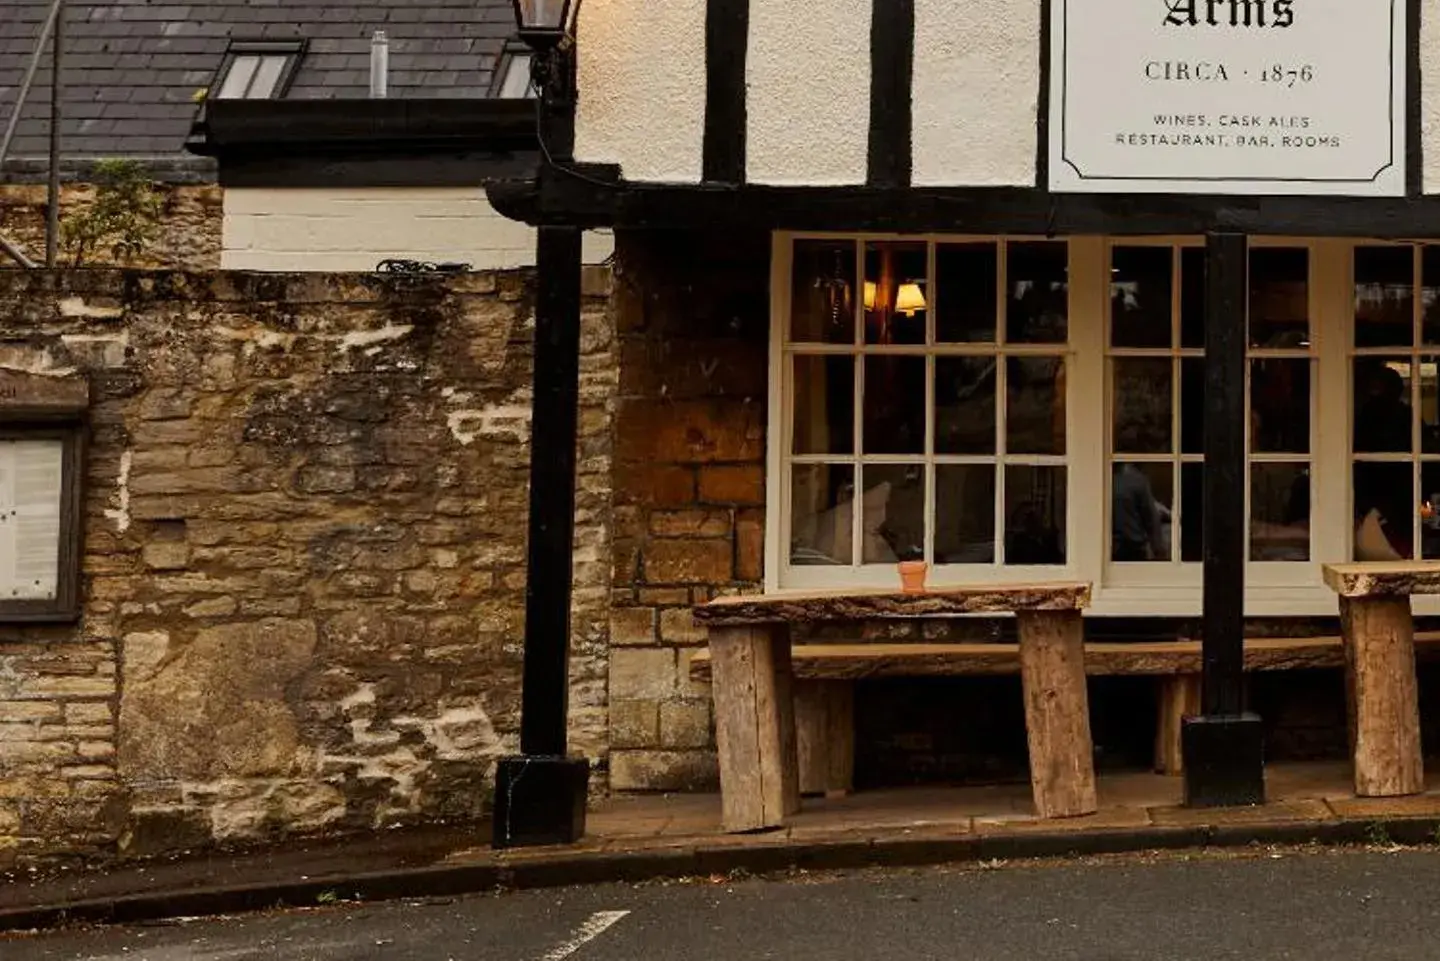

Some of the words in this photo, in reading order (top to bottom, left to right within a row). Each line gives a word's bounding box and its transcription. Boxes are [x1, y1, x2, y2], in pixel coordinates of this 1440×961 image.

[1145, 61, 1229, 82] CIRCA
[1260, 64, 1314, 88] 1876
[1218, 115, 1262, 127] CASK
[1268, 116, 1310, 128] ALES
[1282, 135, 1341, 148] ROOMS
